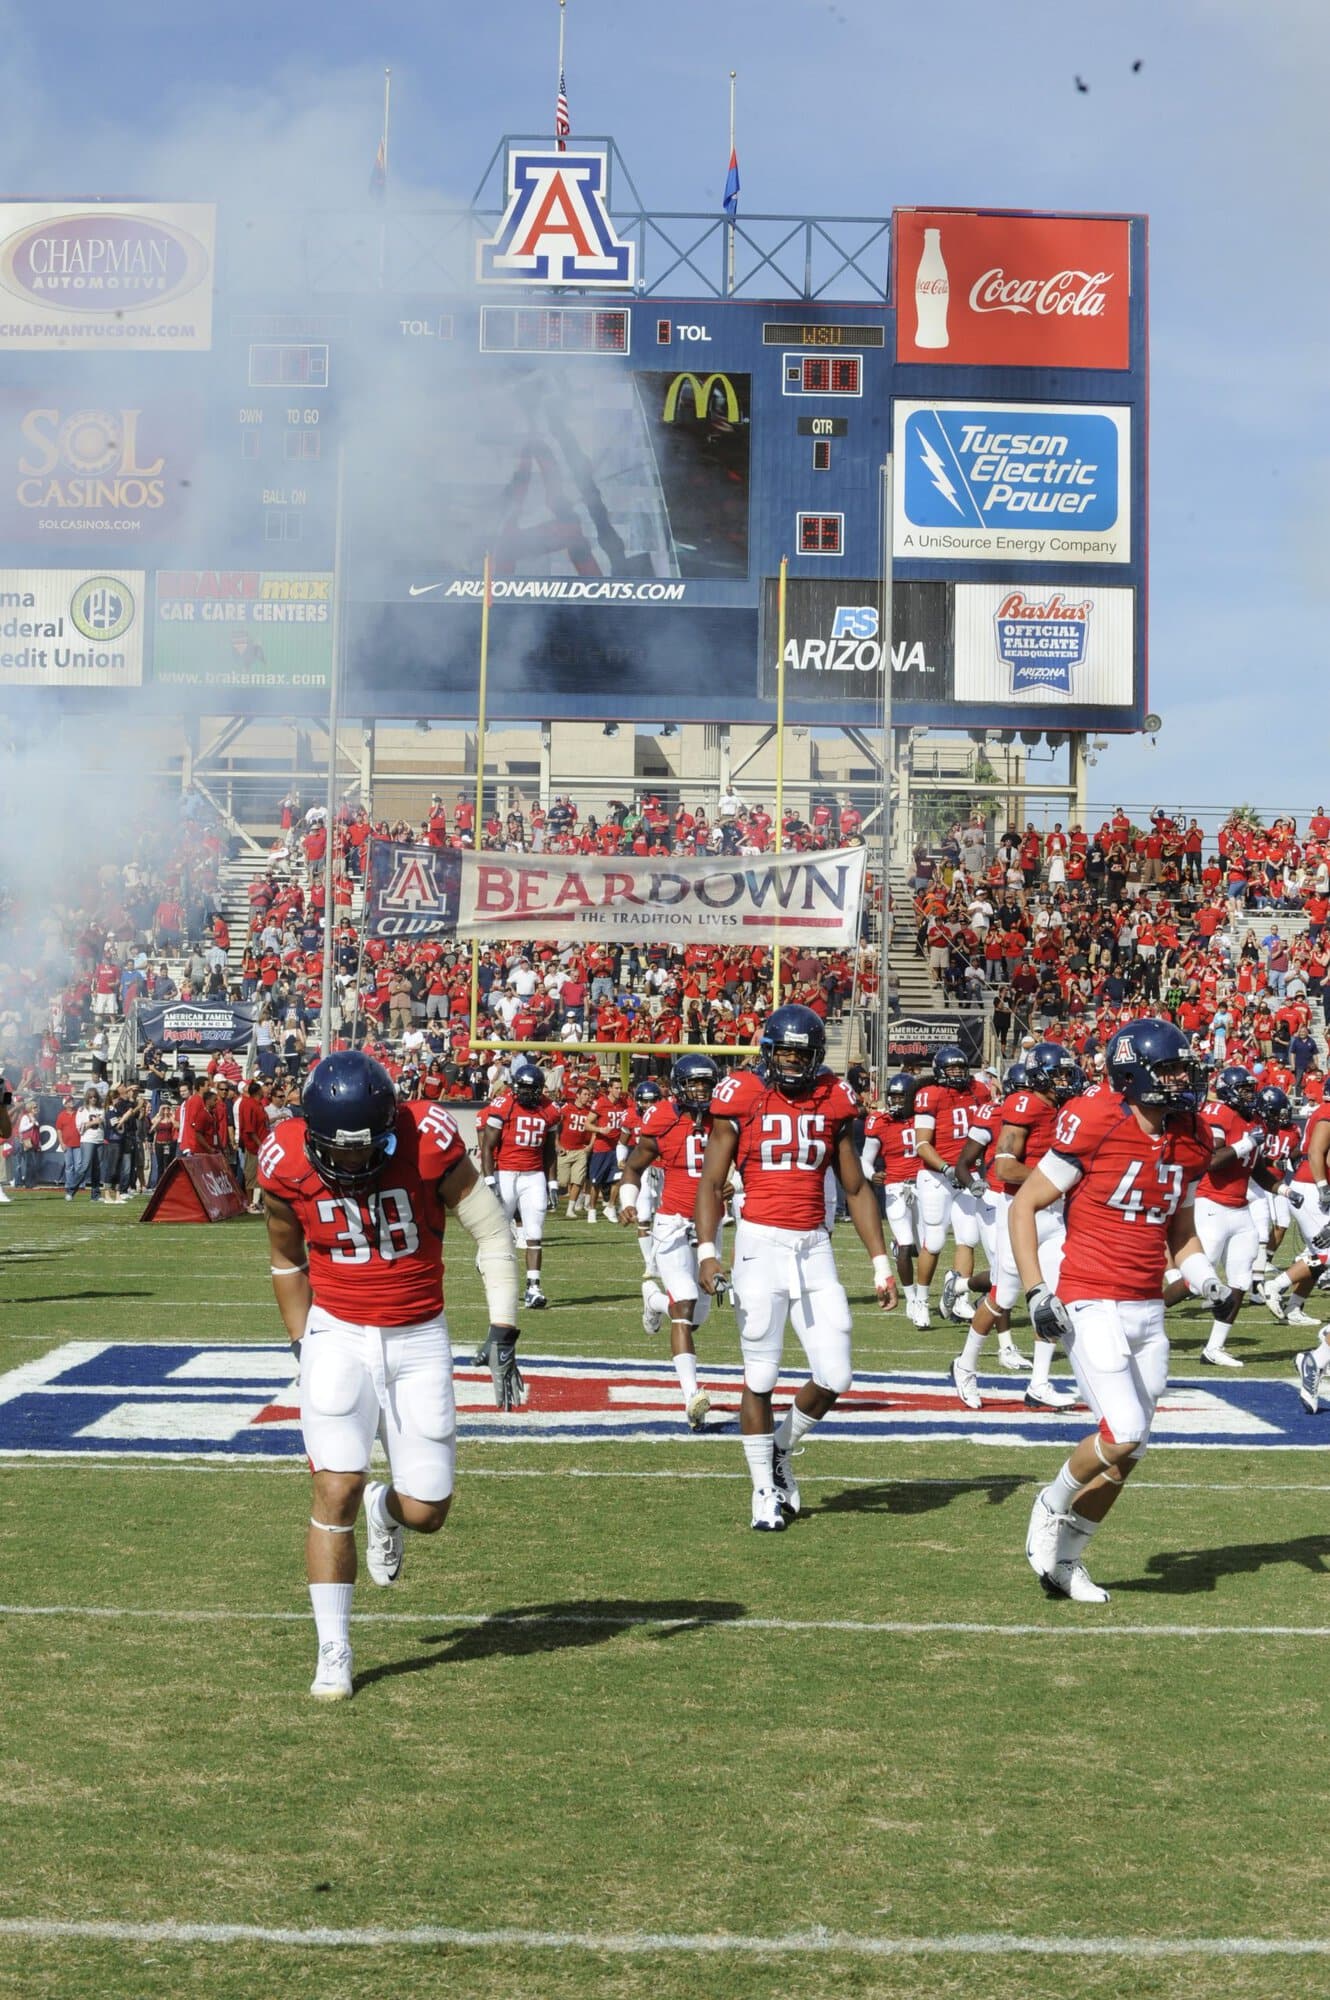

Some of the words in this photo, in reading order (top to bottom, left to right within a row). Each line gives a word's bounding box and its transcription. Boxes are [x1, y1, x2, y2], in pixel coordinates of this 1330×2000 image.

[29, 239, 168, 274] CHAPMAN
[33, 277, 166, 289] AUTOMOTIVE
[968, 268, 1115, 316] Coca-Cola
[0, 325, 196, 337] CHAPMANTUCSON.COM
[400, 321, 434, 336] TOL
[677, 326, 712, 341] TOL
[239, 409, 262, 424] DWN
[287, 409, 300, 424] TO
[304, 409, 319, 424] GO
[812, 419, 833, 434] QTR
[19, 409, 165, 476] SOL
[960, 425, 1068, 455] Tucson
[970, 455, 1098, 486] Electric
[16, 479, 165, 509] CASINOS
[263, 489, 288, 505] BALL
[291, 490, 306, 505] ON
[983, 484, 1097, 514] Power
[39, 520, 141, 530] SOLCASINOS.COM
[904, 535, 914, 546] A
[919, 535, 991, 550] UniSource
[996, 537, 1045, 553] Energy
[1050, 538, 1116, 554] Company
[445, 580, 686, 600] ARIZONAWILDCATS.COM
[160, 603, 195, 621] CAR
[202, 603, 246, 621] CARE
[253, 603, 328, 622] CENTERS
[998, 594, 1090, 620] Bashas'
[0, 618, 64, 638] deral
[832, 606, 879, 639] FS
[1004, 625, 1079, 637] OFFICIAL
[1004, 638, 1079, 650] TAILGATE
[1004, 650, 1078, 658] HEADQUARTERS
[54, 648, 125, 668] Union
[776, 639, 926, 672] ARIZONA
[159, 672, 327, 685] www.brakemax.com
[1016, 667, 1066, 677] ARIZONA
[580, 912, 606, 923] THE
[612, 912, 694, 925] TRADITION
[698, 914, 737, 925] LIVES
[515, 1116, 545, 1147] 52
[1056, 1110, 1081, 1145] 43
[760, 1114, 826, 1171] 26
[1107, 1161, 1183, 1225] 43
[317, 1188, 419, 1265] 38
